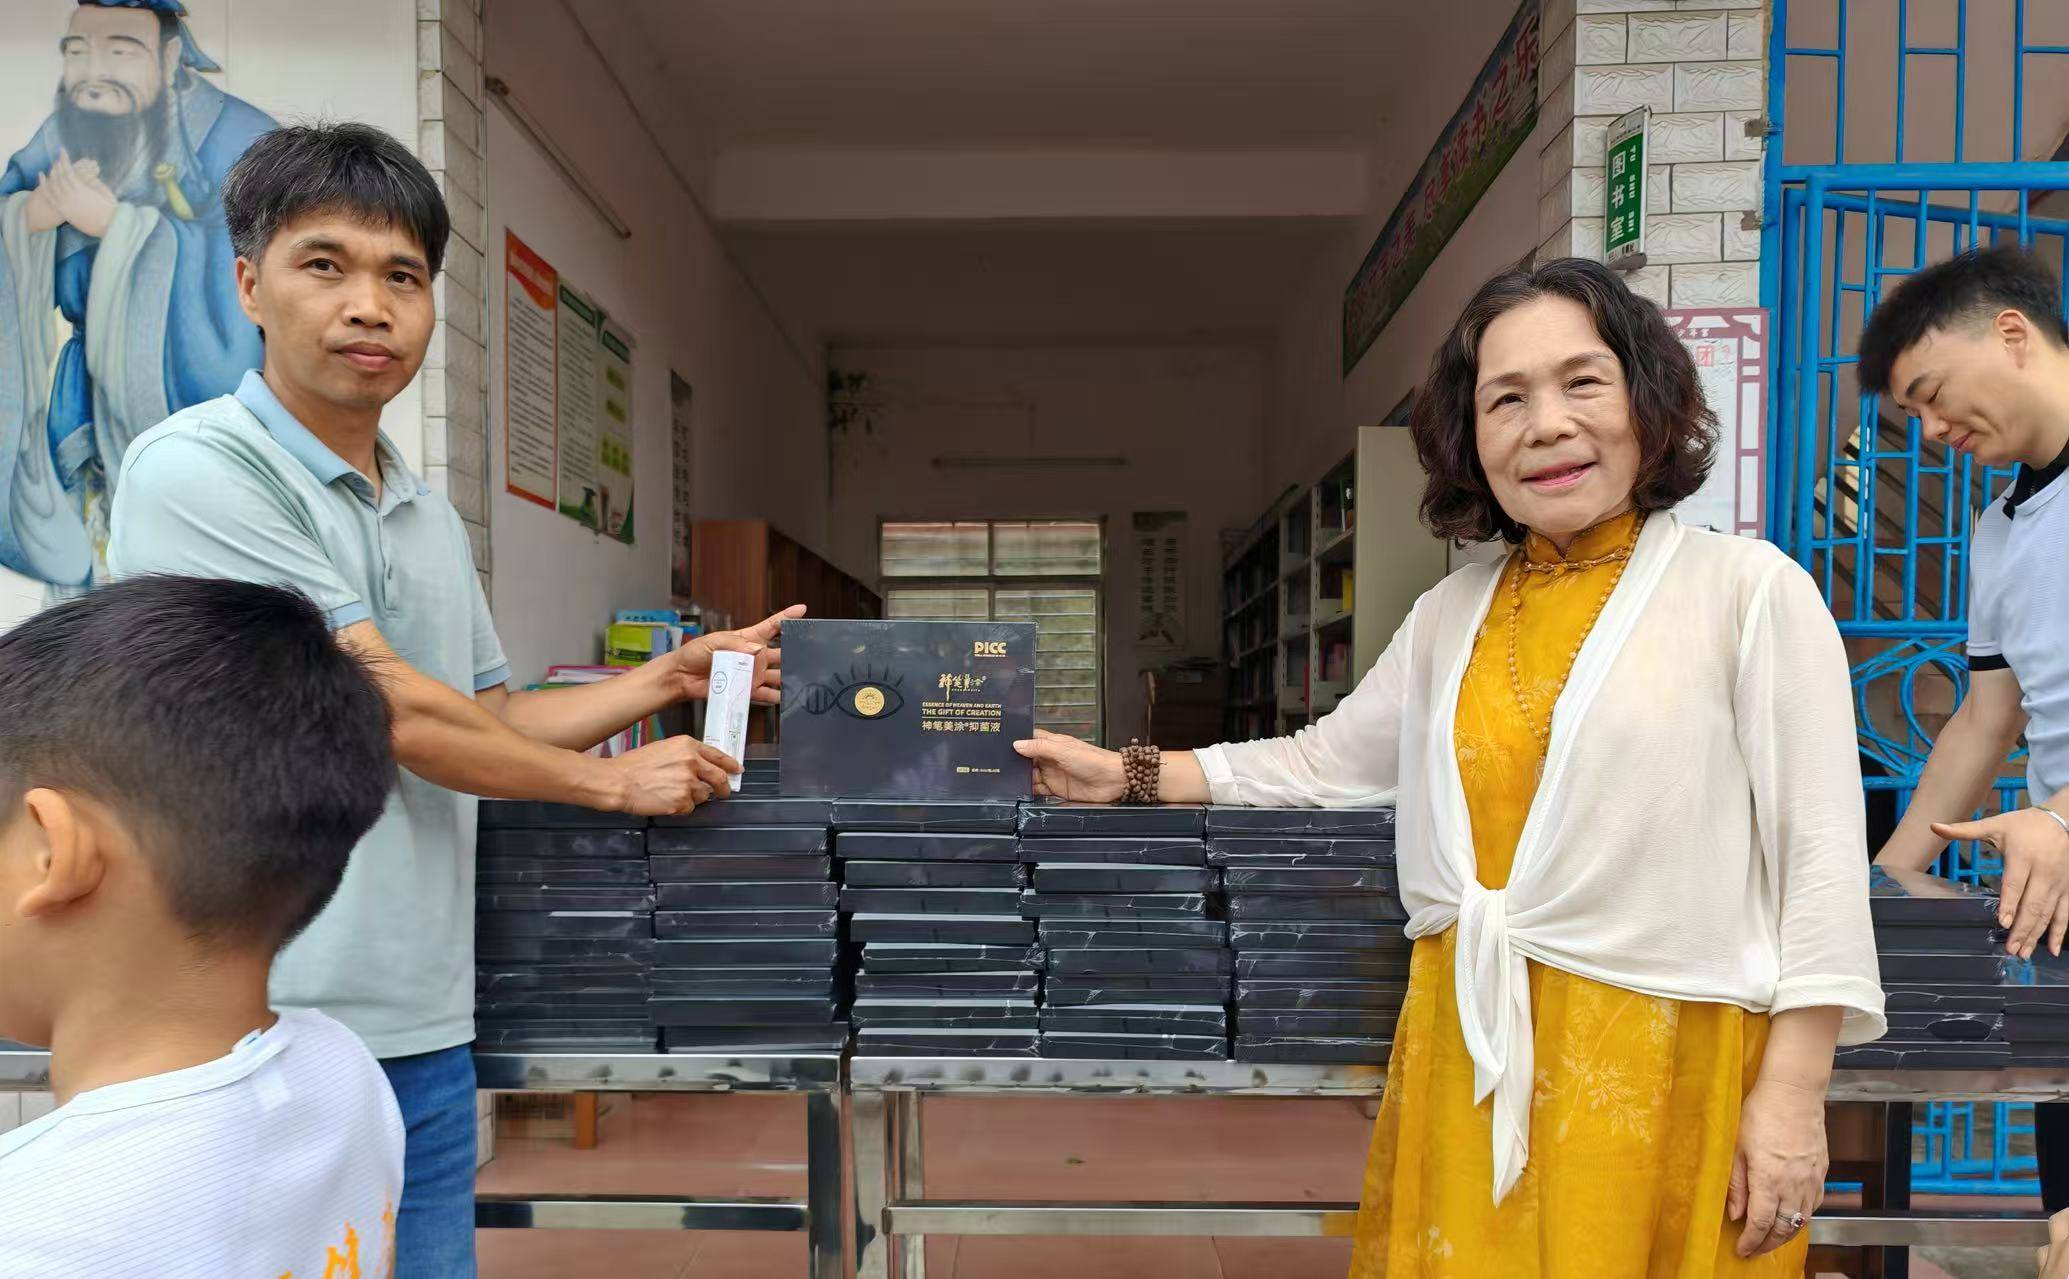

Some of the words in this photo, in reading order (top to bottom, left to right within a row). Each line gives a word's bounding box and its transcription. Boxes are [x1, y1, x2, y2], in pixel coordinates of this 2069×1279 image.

[1610, 151, 1626, 243] 图书室
[974, 641, 1006, 654] PICC
[966, 709, 1001, 717] CREATION
